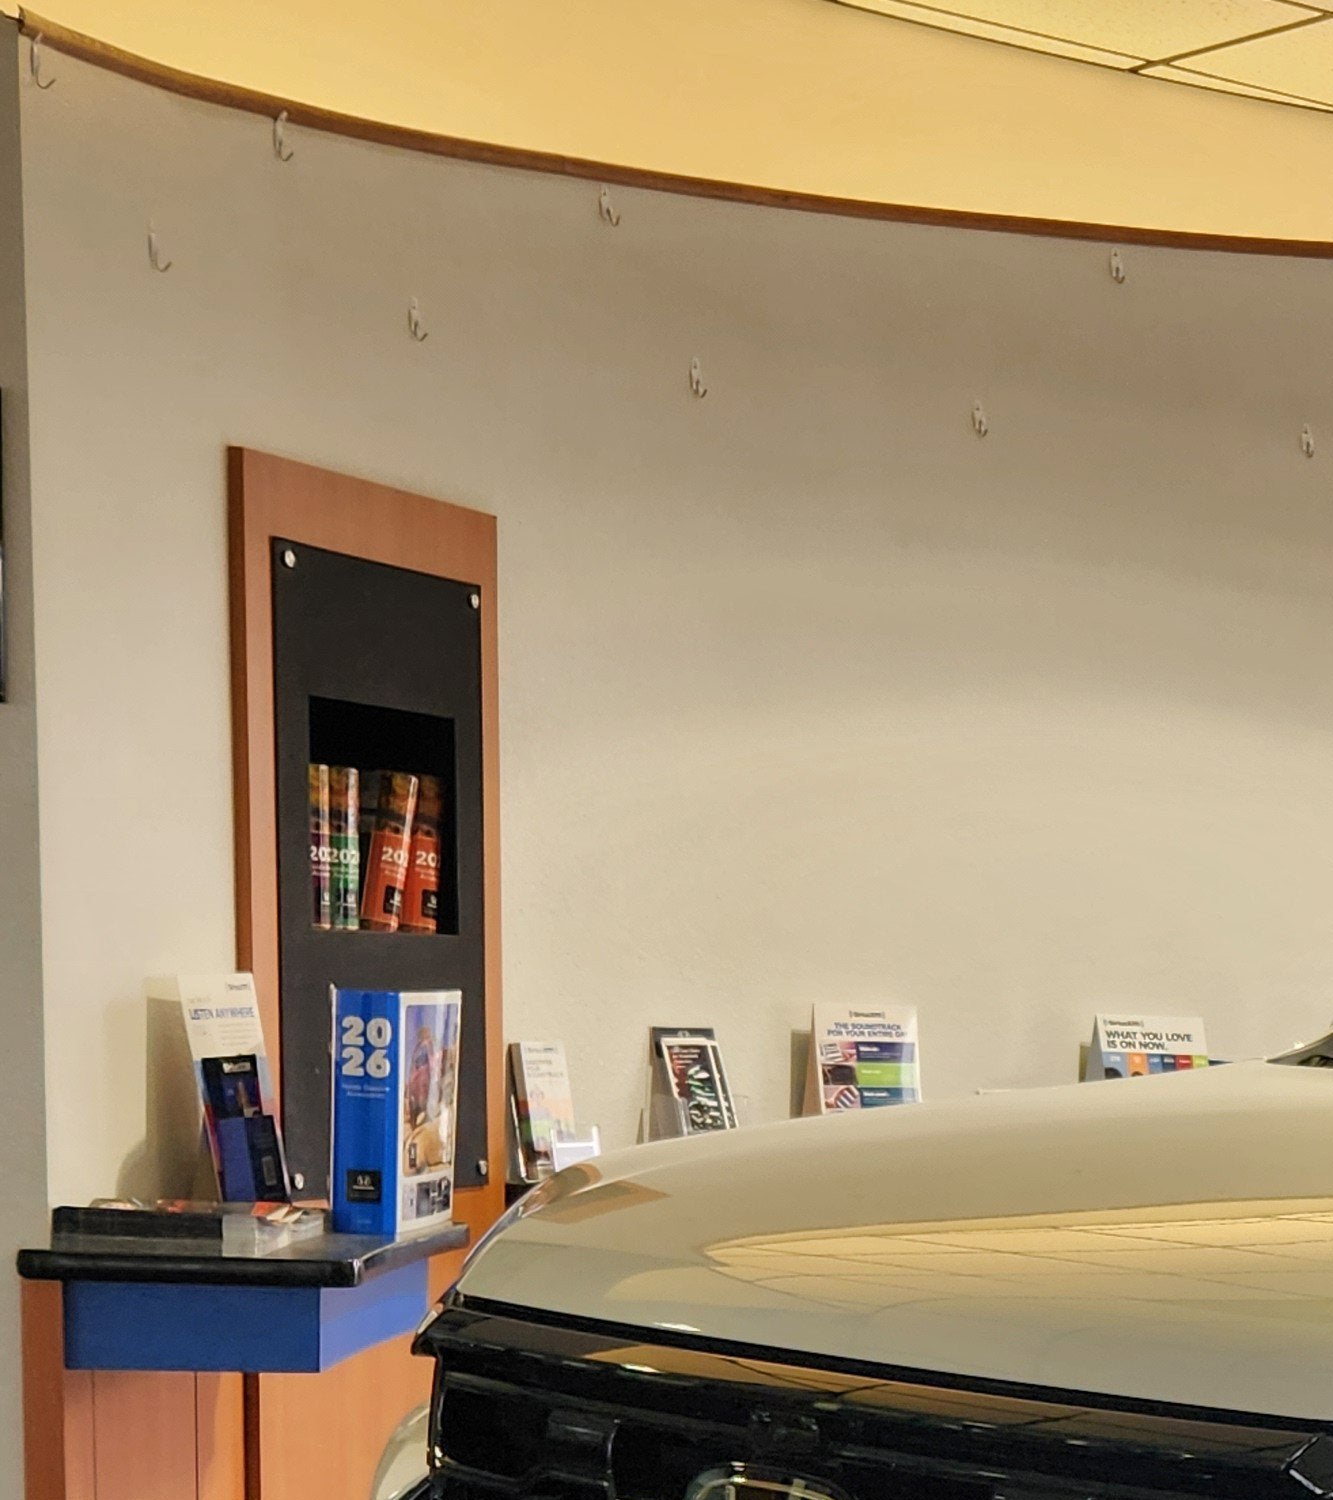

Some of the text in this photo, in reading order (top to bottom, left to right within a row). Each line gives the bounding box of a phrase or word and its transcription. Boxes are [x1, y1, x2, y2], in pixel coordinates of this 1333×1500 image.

[341, 1015, 392, 1048] 20
[834, 1022, 902, 1030] THE SOUNDTRACK
[827, 1029, 843, 1037] FOR
[846, 1029, 865, 1037] YOUR
[1105, 1030, 1193, 1042] WHAT YOU LOVE
[1106, 1040, 1117, 1049] IS
[1119, 1040, 1136, 1050] ON
[341, 1046, 391, 1078] 26
